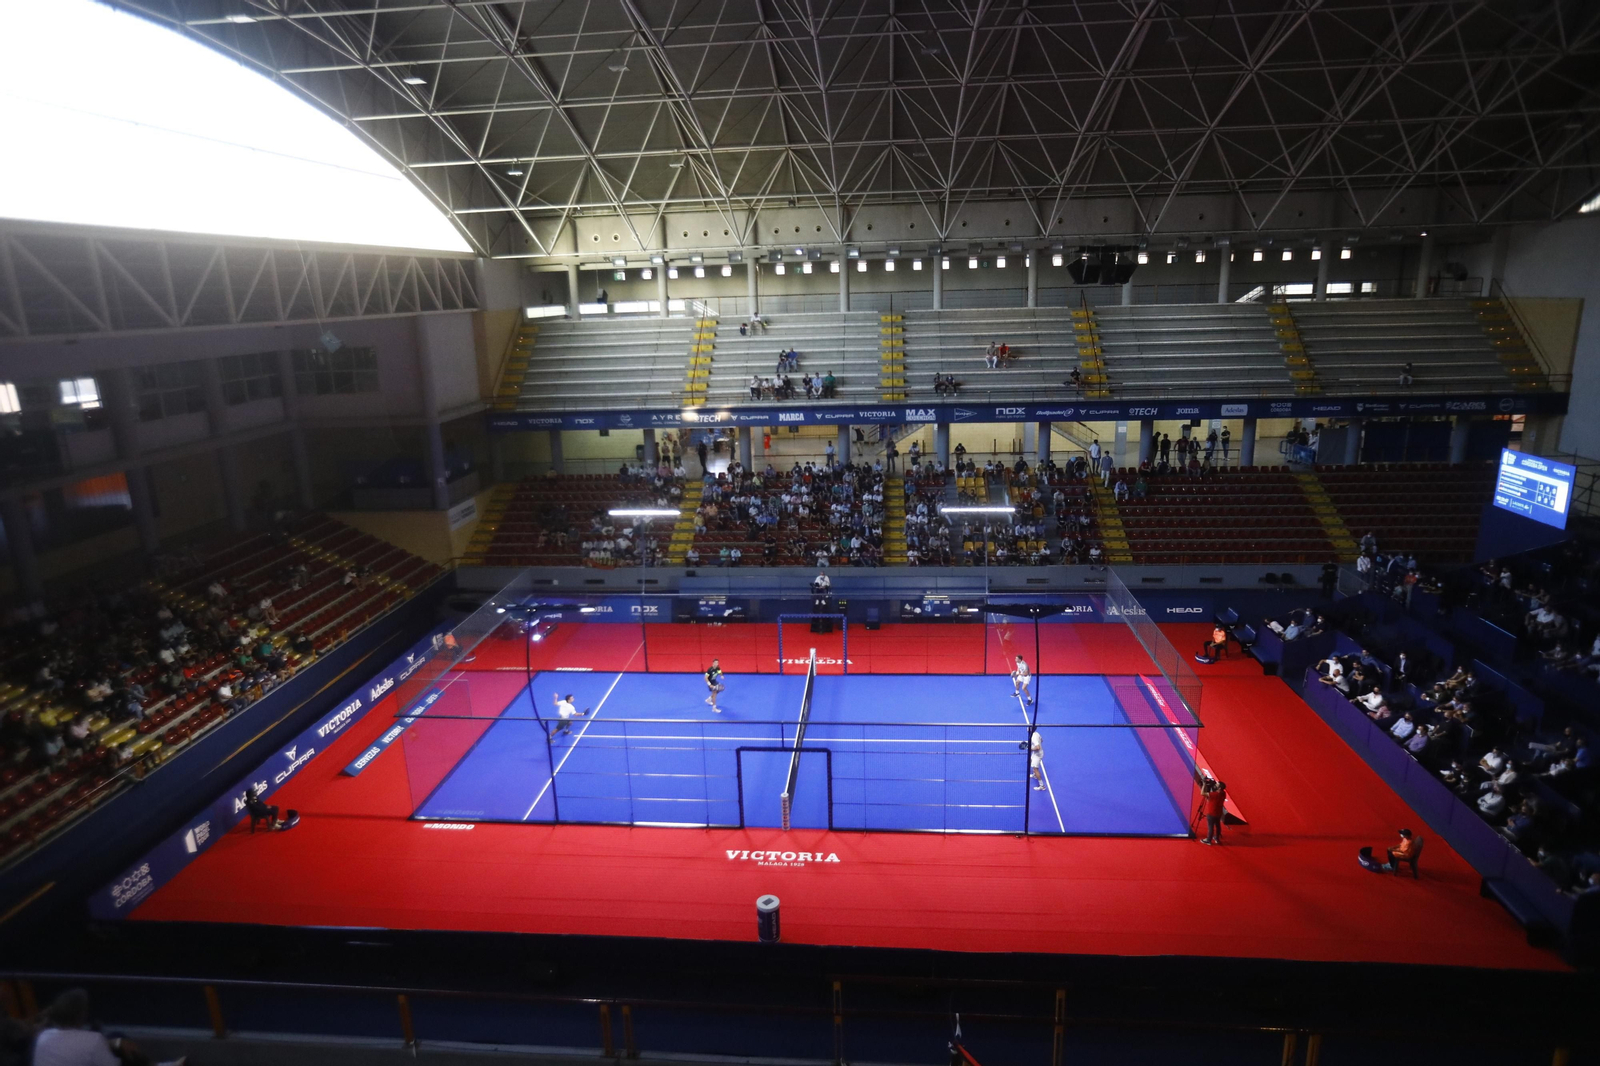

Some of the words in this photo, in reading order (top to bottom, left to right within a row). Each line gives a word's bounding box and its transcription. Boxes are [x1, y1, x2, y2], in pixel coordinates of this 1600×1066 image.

[779, 413, 805, 421] MARCA
[400, 656, 425, 681] CUPRA
[370, 677, 394, 702] Adeslas
[318, 699, 362, 738] VICTORIA
[275, 748, 315, 784] CUPRA
[354, 746, 380, 769] CERVEZAS
[726, 850, 841, 863] VICTORIA
